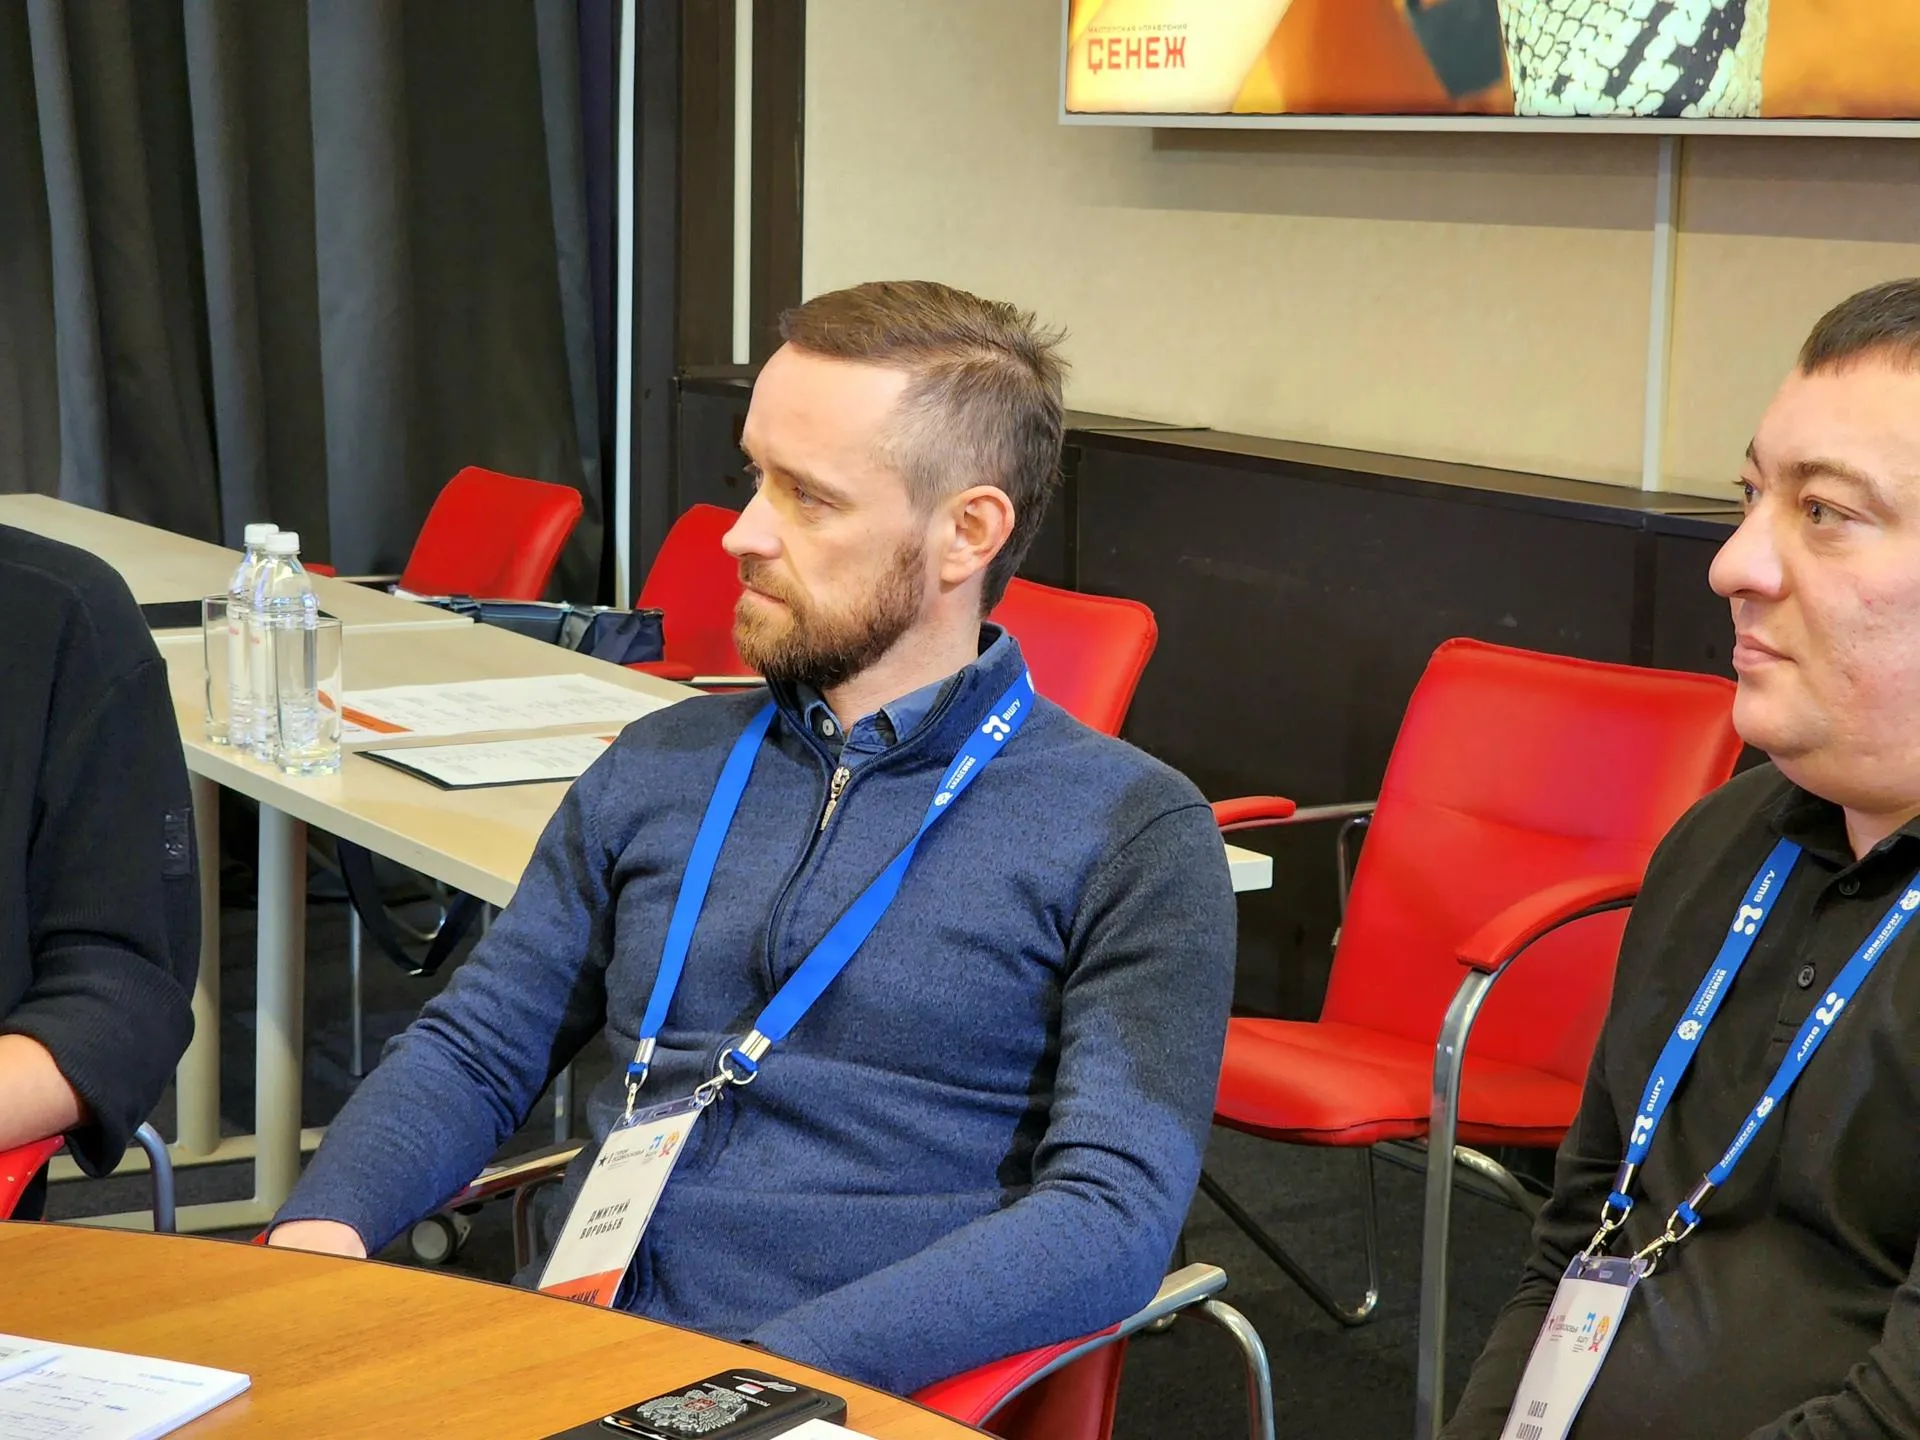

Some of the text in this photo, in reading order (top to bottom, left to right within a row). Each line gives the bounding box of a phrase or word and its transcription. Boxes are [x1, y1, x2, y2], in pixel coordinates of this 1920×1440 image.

[1752, 869, 1776, 903] ВШГУ
[1698, 968, 1727, 1017] АКАДЕМИЯ
[1796, 1025, 1821, 1062] ВШГУ
[1646, 1075, 1665, 1112] ВШГУ
[579, 1217, 624, 1240] ВОРОБЬЕВ
[587, 1199, 631, 1225] ДМИТРИЙ
